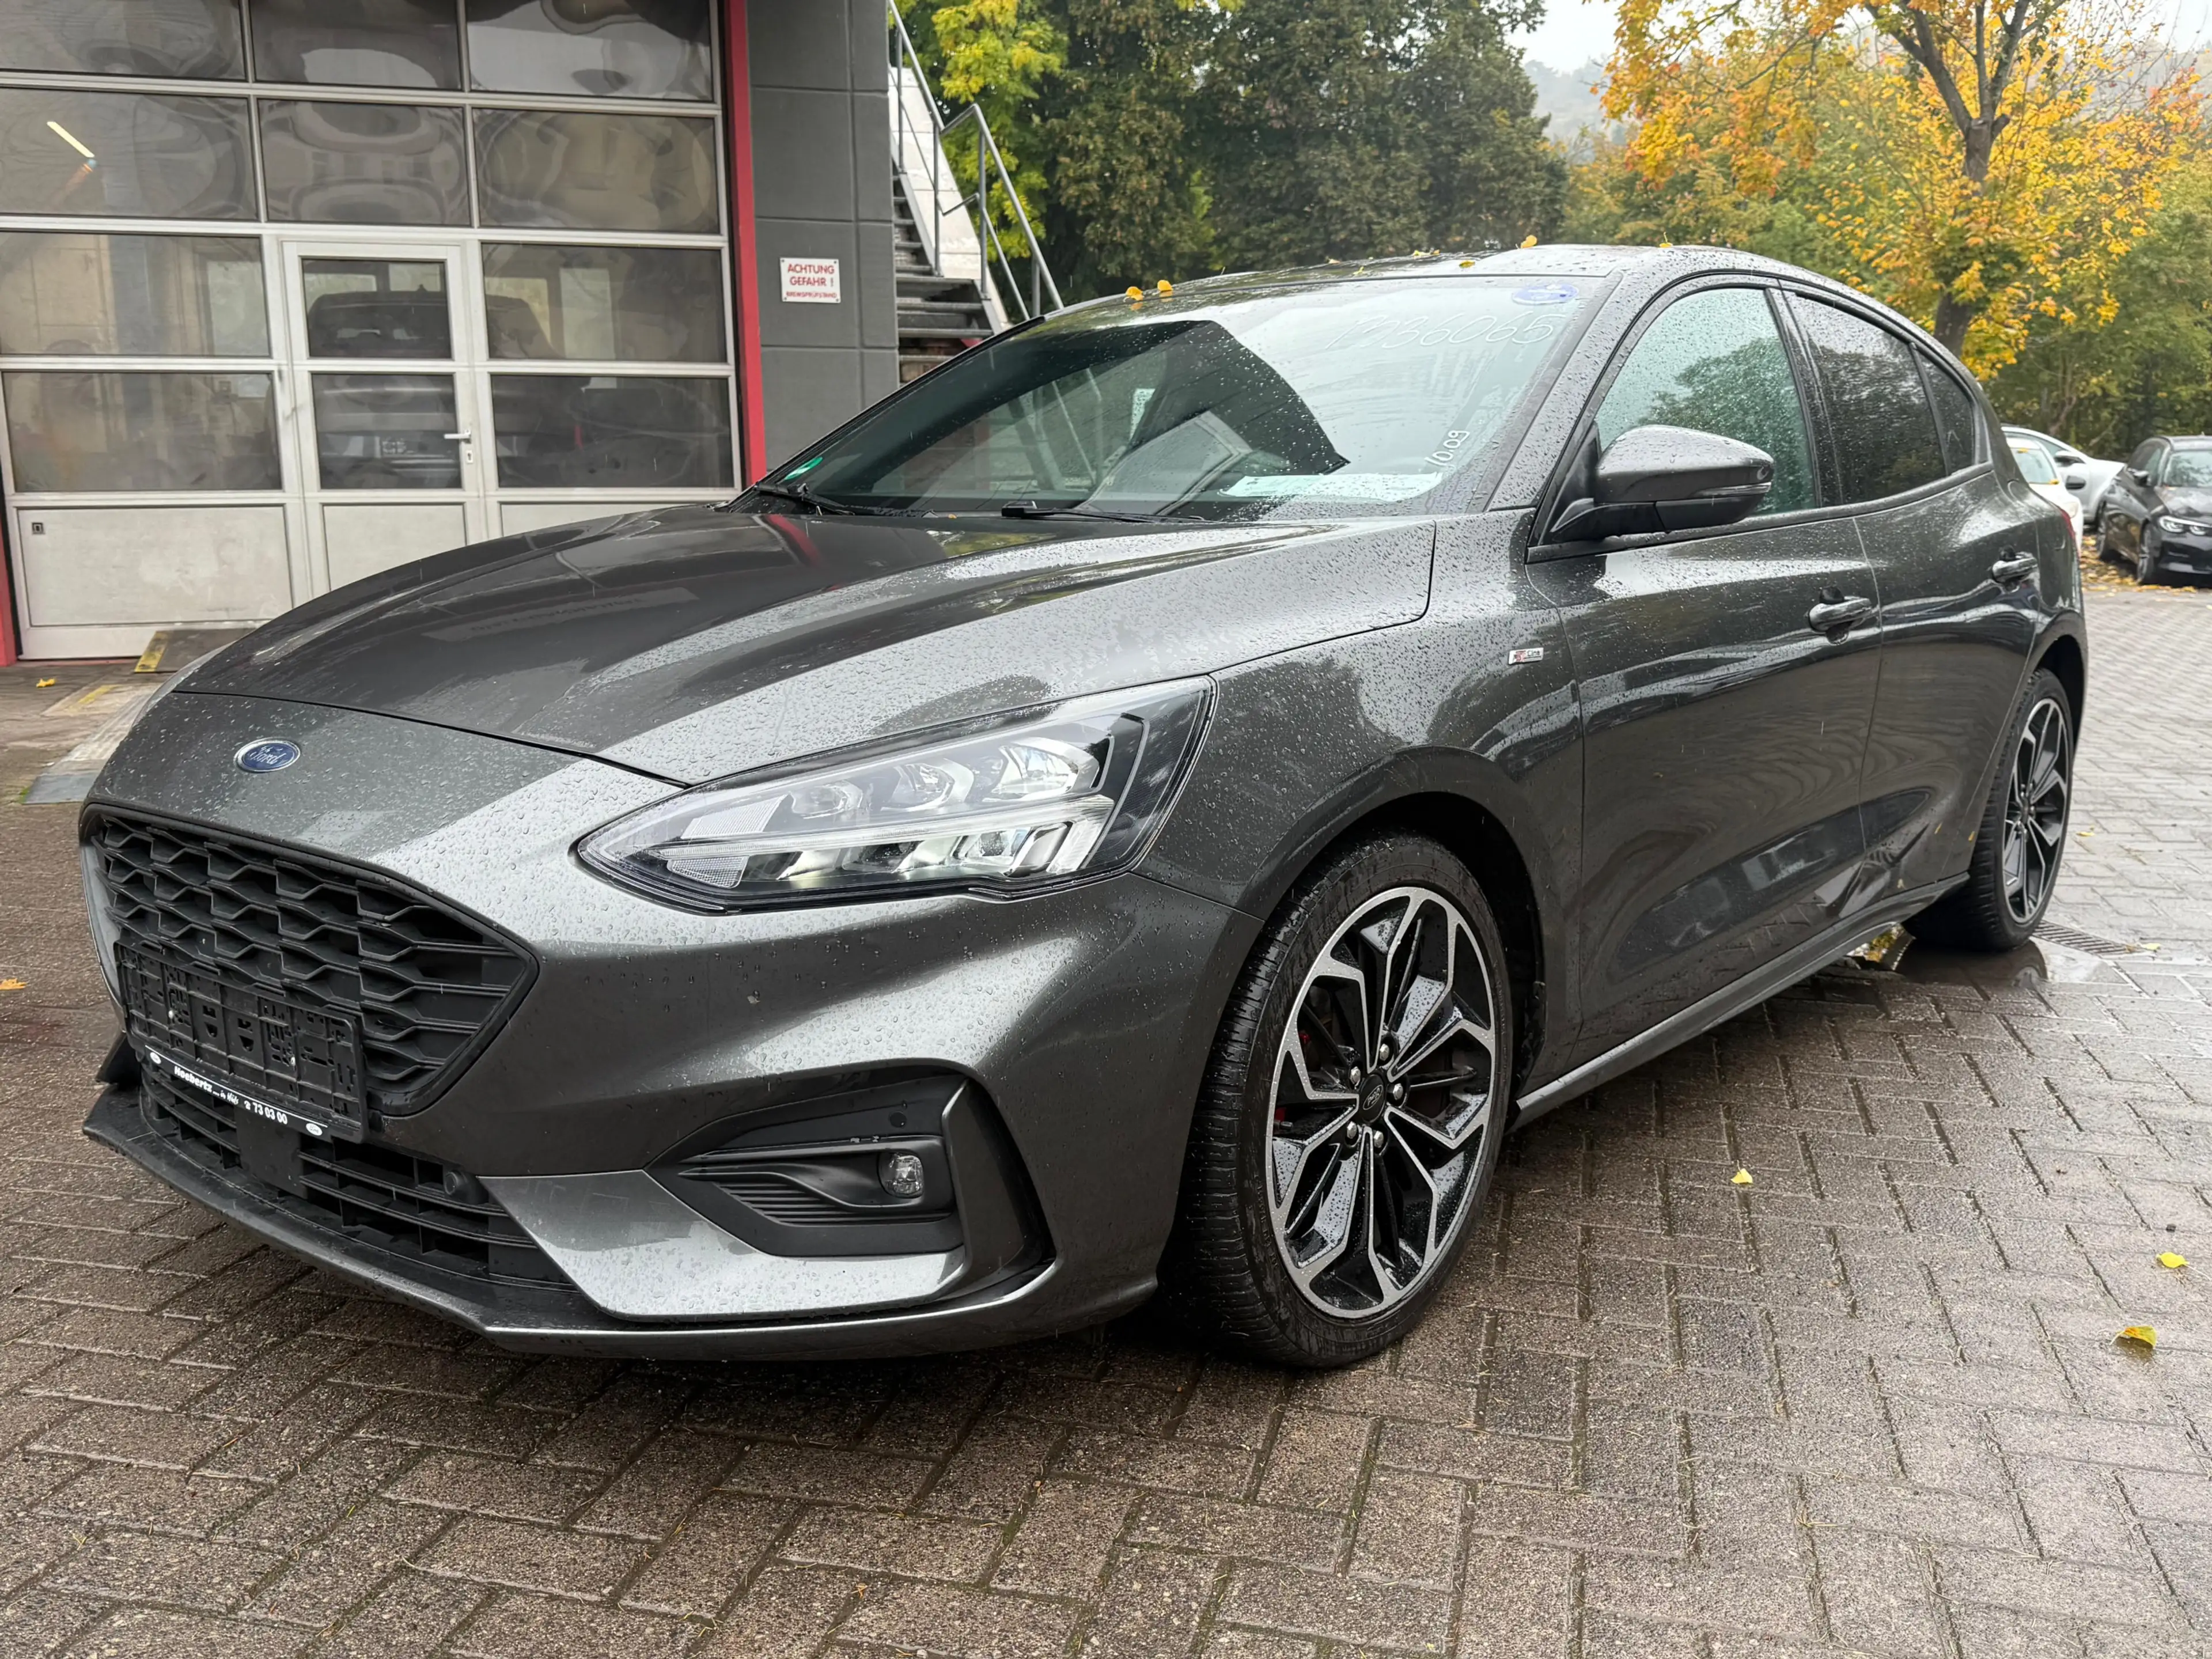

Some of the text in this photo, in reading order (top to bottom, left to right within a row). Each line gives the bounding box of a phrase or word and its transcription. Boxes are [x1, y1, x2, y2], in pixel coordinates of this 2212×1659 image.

[787, 264, 835, 274] ACHTUNG
[790, 276, 827, 287] GEFAHR
[249, 746, 287, 765] Ford
[174, 1066, 213, 1093] Hoebertz
